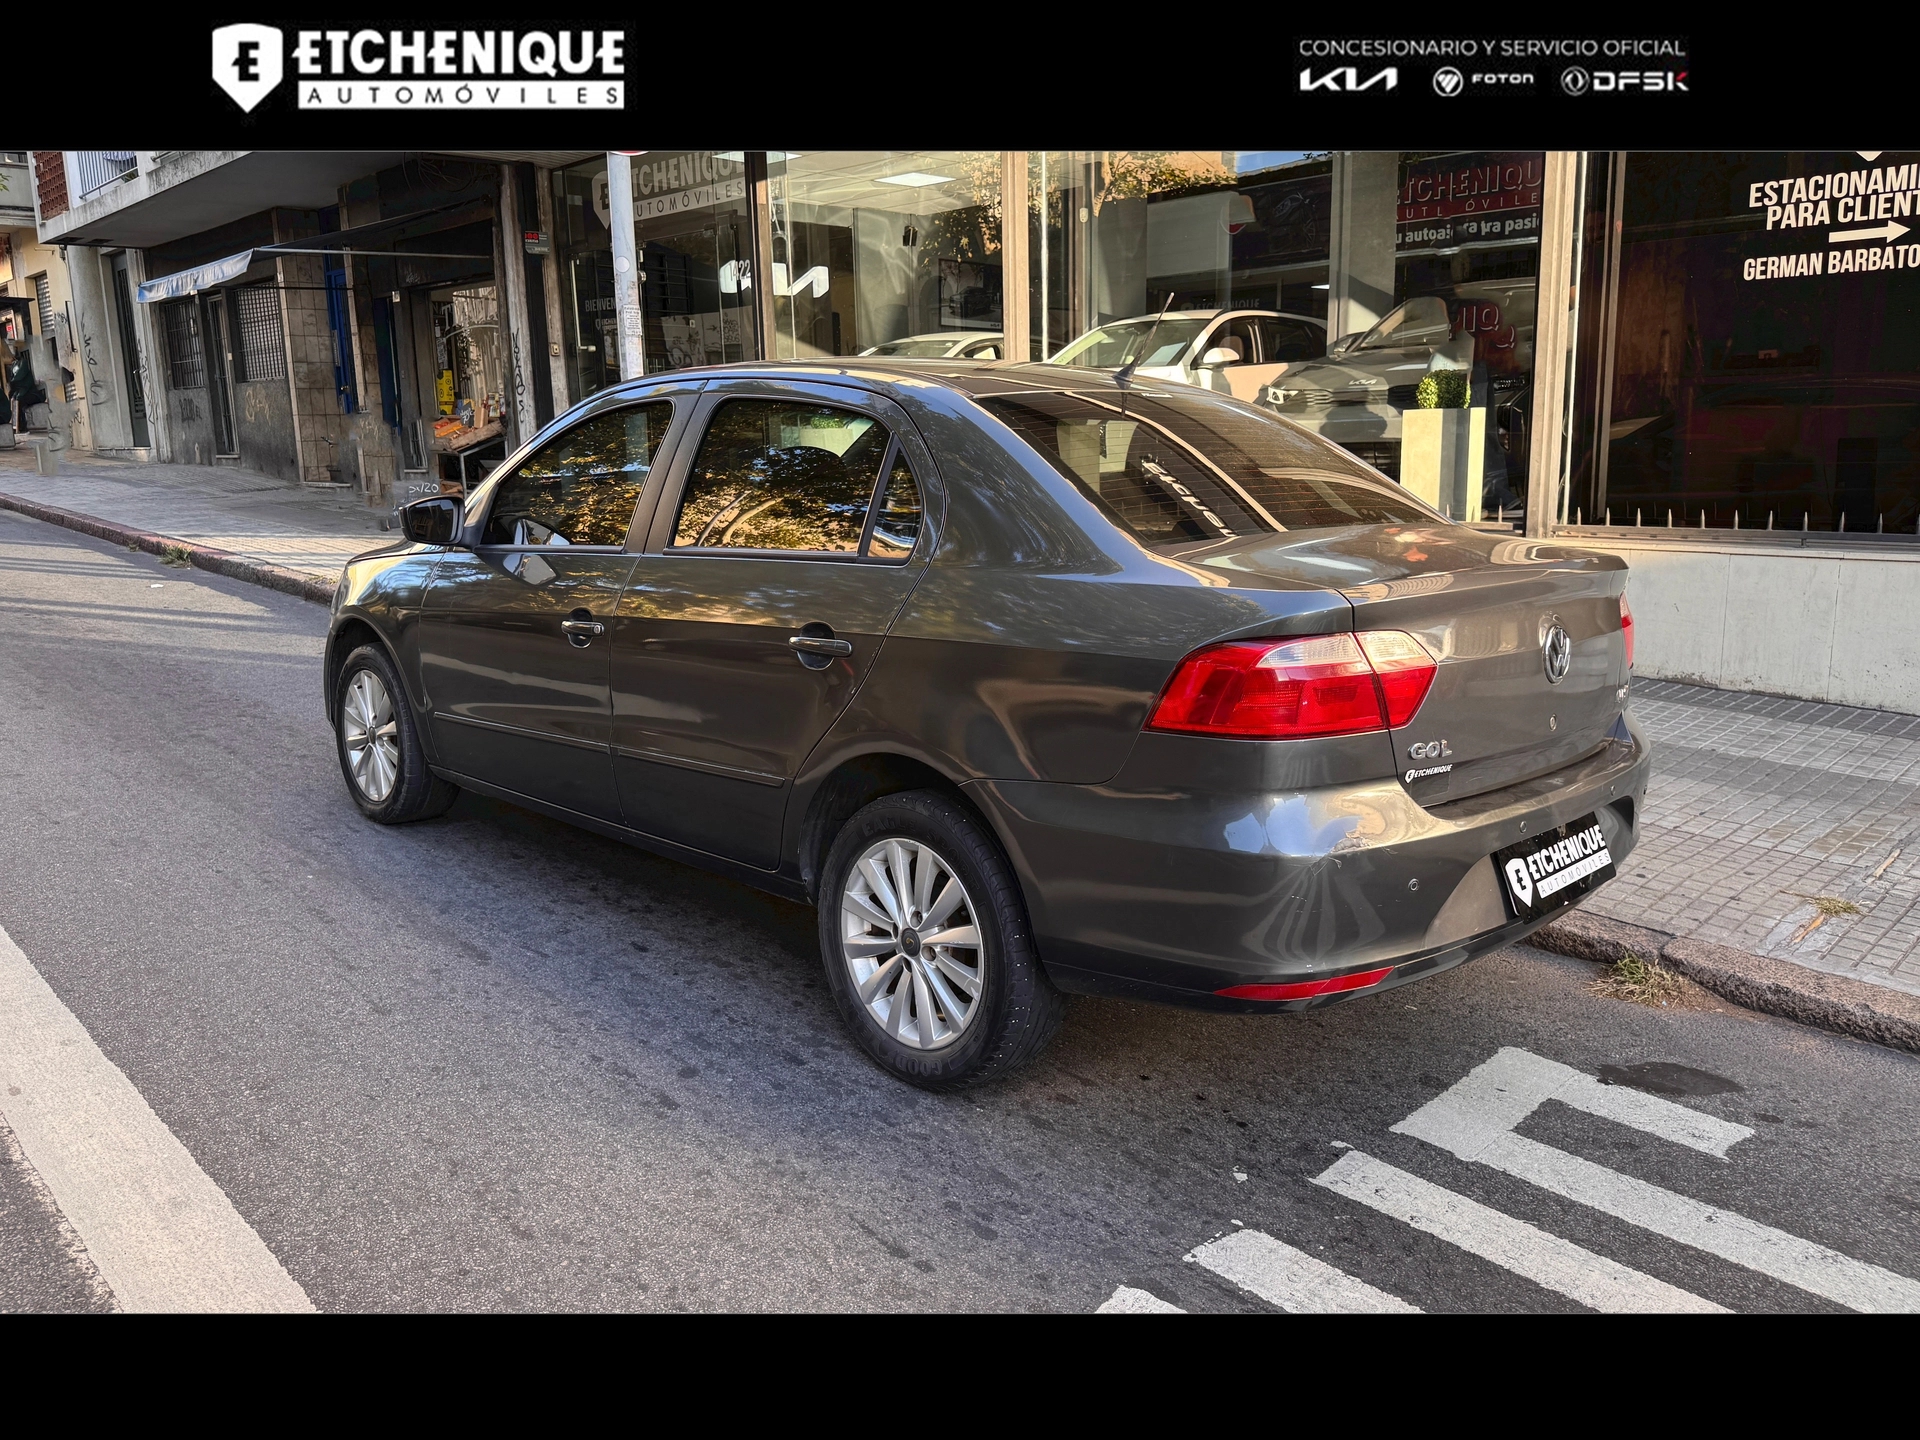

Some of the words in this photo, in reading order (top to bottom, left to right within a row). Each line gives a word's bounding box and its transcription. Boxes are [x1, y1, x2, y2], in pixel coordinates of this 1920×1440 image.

[636, 181, 744, 217] UTOMÓVILES
[1749, 163, 1920, 208] ESTACIONAMI
[1766, 200, 1831, 230] PARA
[1743, 252, 1824, 281] GERMAN
[1827, 243, 1920, 274] BARBATO
[1408, 739, 1453, 760] GOL
[1526, 824, 1606, 880] ETCHENIQUE
